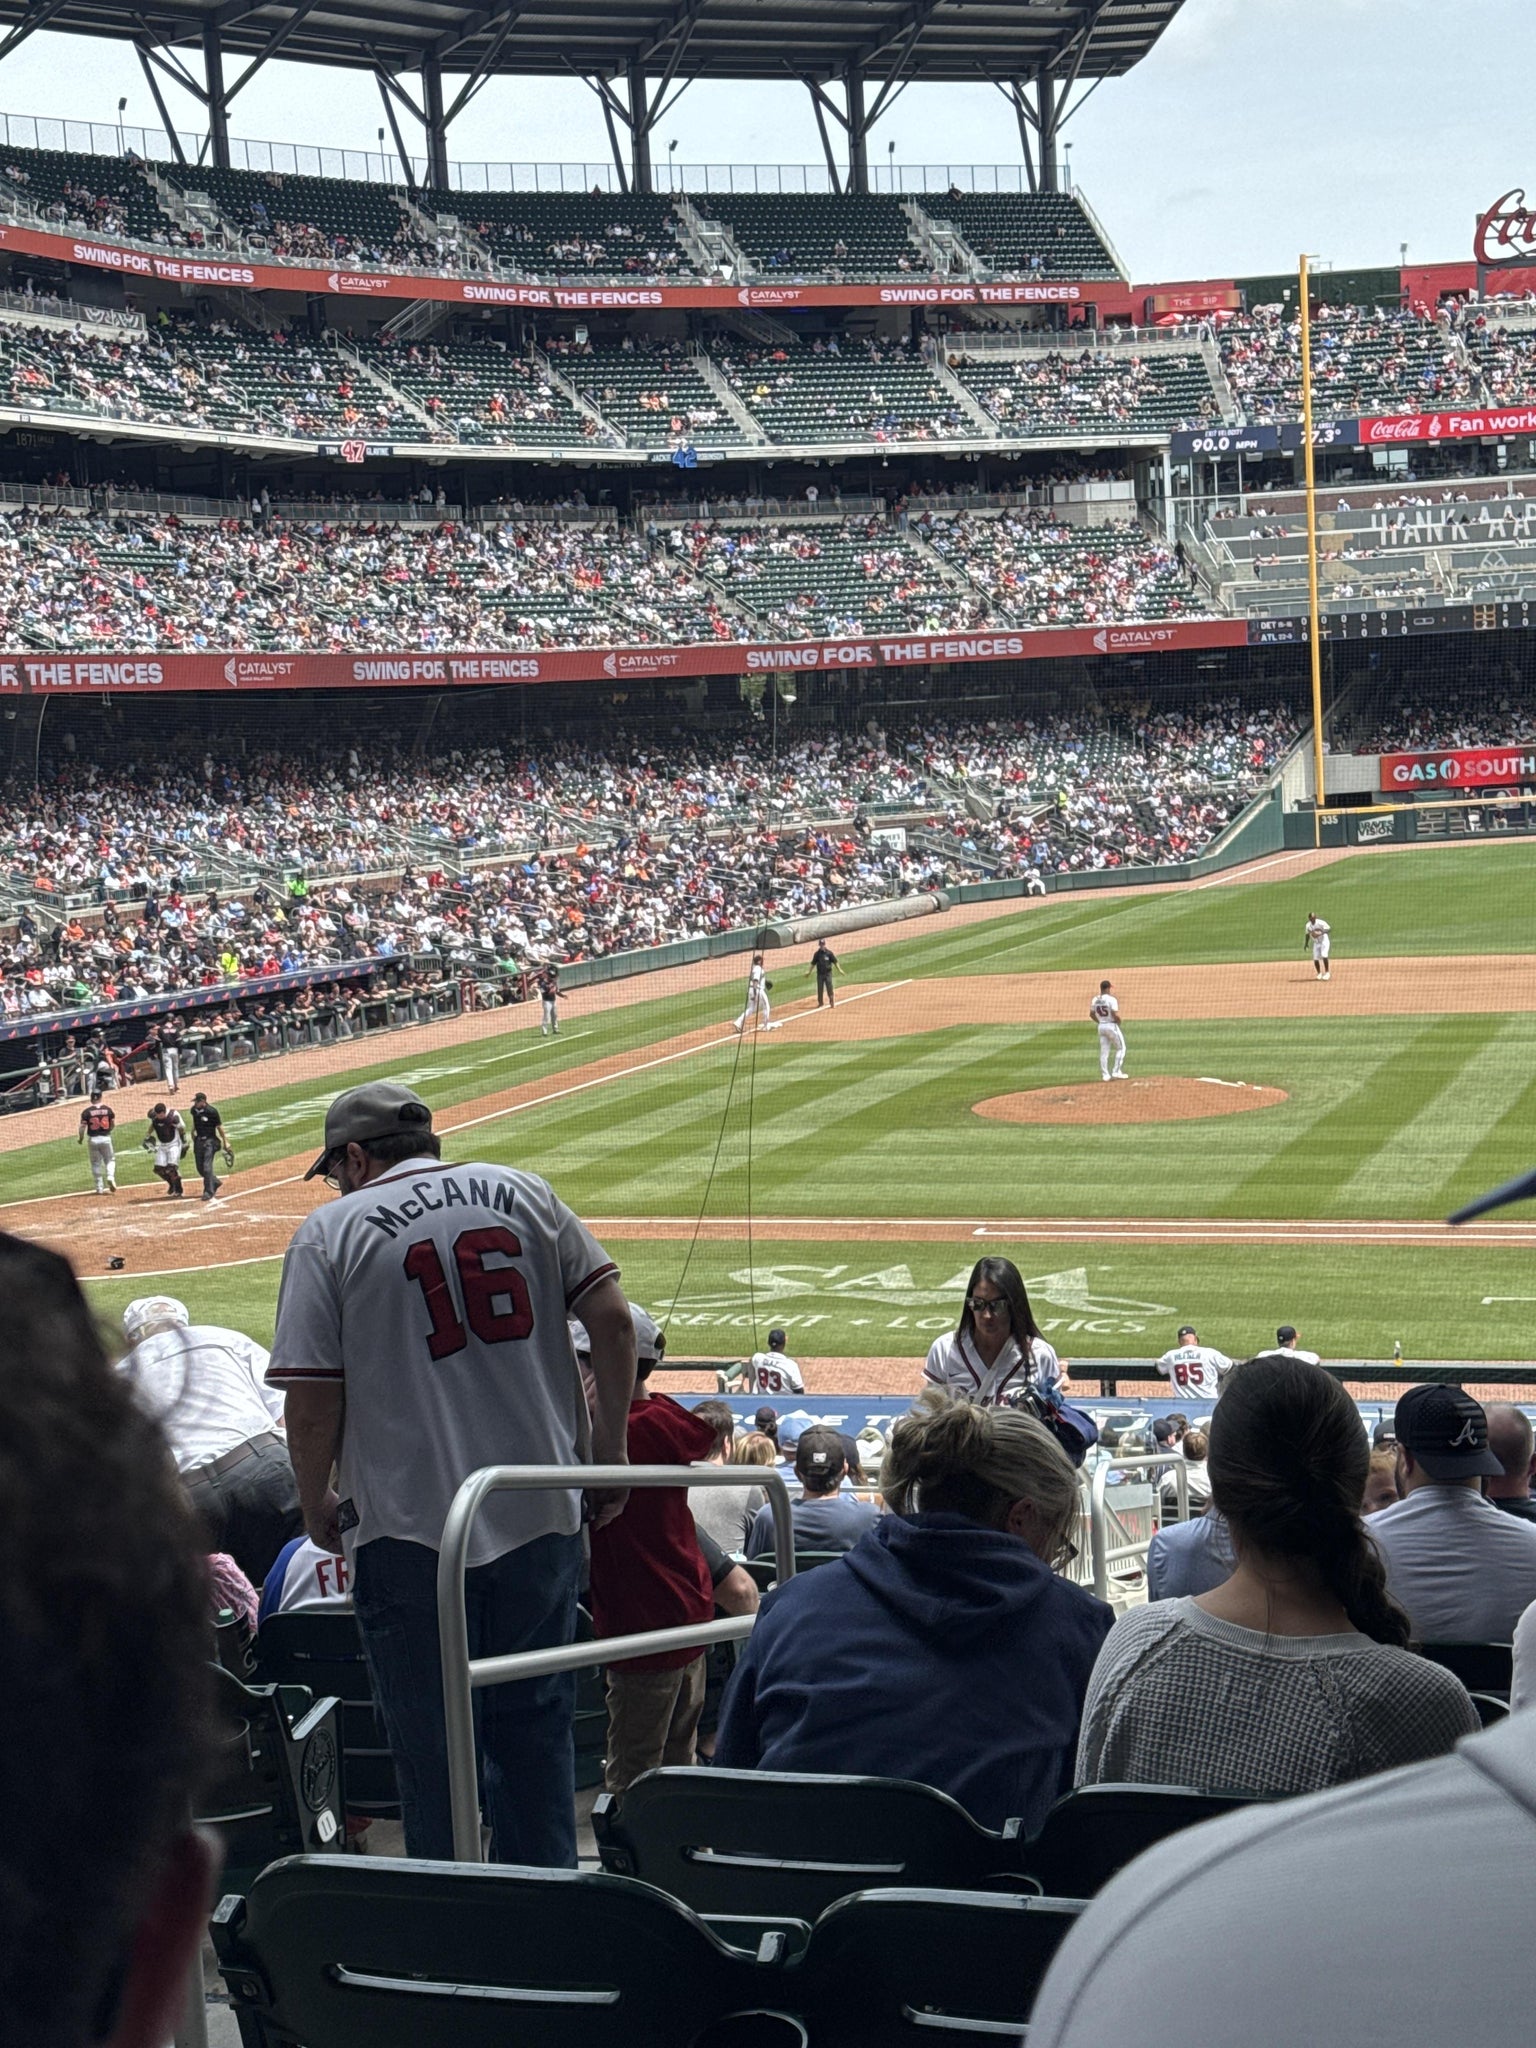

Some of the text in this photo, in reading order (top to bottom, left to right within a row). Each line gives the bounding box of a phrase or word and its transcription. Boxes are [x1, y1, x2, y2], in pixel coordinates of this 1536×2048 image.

[73, 244, 254, 283] SWING FOR THE FENCES
[340, 276, 390, 289] CATALYST
[463, 285, 662, 305] SWING FOR THE FENCES
[750, 290, 800, 300] CATALYST
[880, 286, 1080, 302] SWING FOR THE FENCES
[1173, 298, 1192, 306] THE
[1449, 417, 1484, 432] Fan
[340, 440, 366, 463] 47
[1192, 436, 1258, 453] 90.0 MPH
[672, 446, 697, 468] 42
[1371, 509, 1470, 546] HANK
[1260, 621, 1277, 630] DET
[1320, 615, 1327, 624] 0
[1341, 614, 1347, 623] 0
[1361, 613, 1367, 622] 0
[1381, 611, 1387, 621] 0
[1522, 602, 1528, 611] 0
[1109, 630, 1174, 642] CATALYST
[1260, 633, 1278, 641] ATL
[1361, 628, 1368, 637] 0
[1381, 627, 1388, 636] 0
[1401, 625, 1408, 634] 0
[1522, 617, 1529, 627] 0
[619, 654, 678, 667] CATALYST
[746, 638, 1024, 668] SWING FOR THE FENCES
[25, 664, 72, 686] THE
[75, 663, 164, 685] FENCES
[238, 662, 293, 675] CATALYST
[353, 659, 540, 680] SWING FOR THE FENCES
[1393, 756, 1536, 782] GAS SOUTH
[1321, 815, 1339, 825] 335
[365, 1176, 516, 1239] McCANN
[403, 1226, 535, 1361] 16
[650, 1312, 833, 1328] REIGHT
[757, 1367, 782, 1392] 83
[1174, 1362, 1204, 1386] 85
